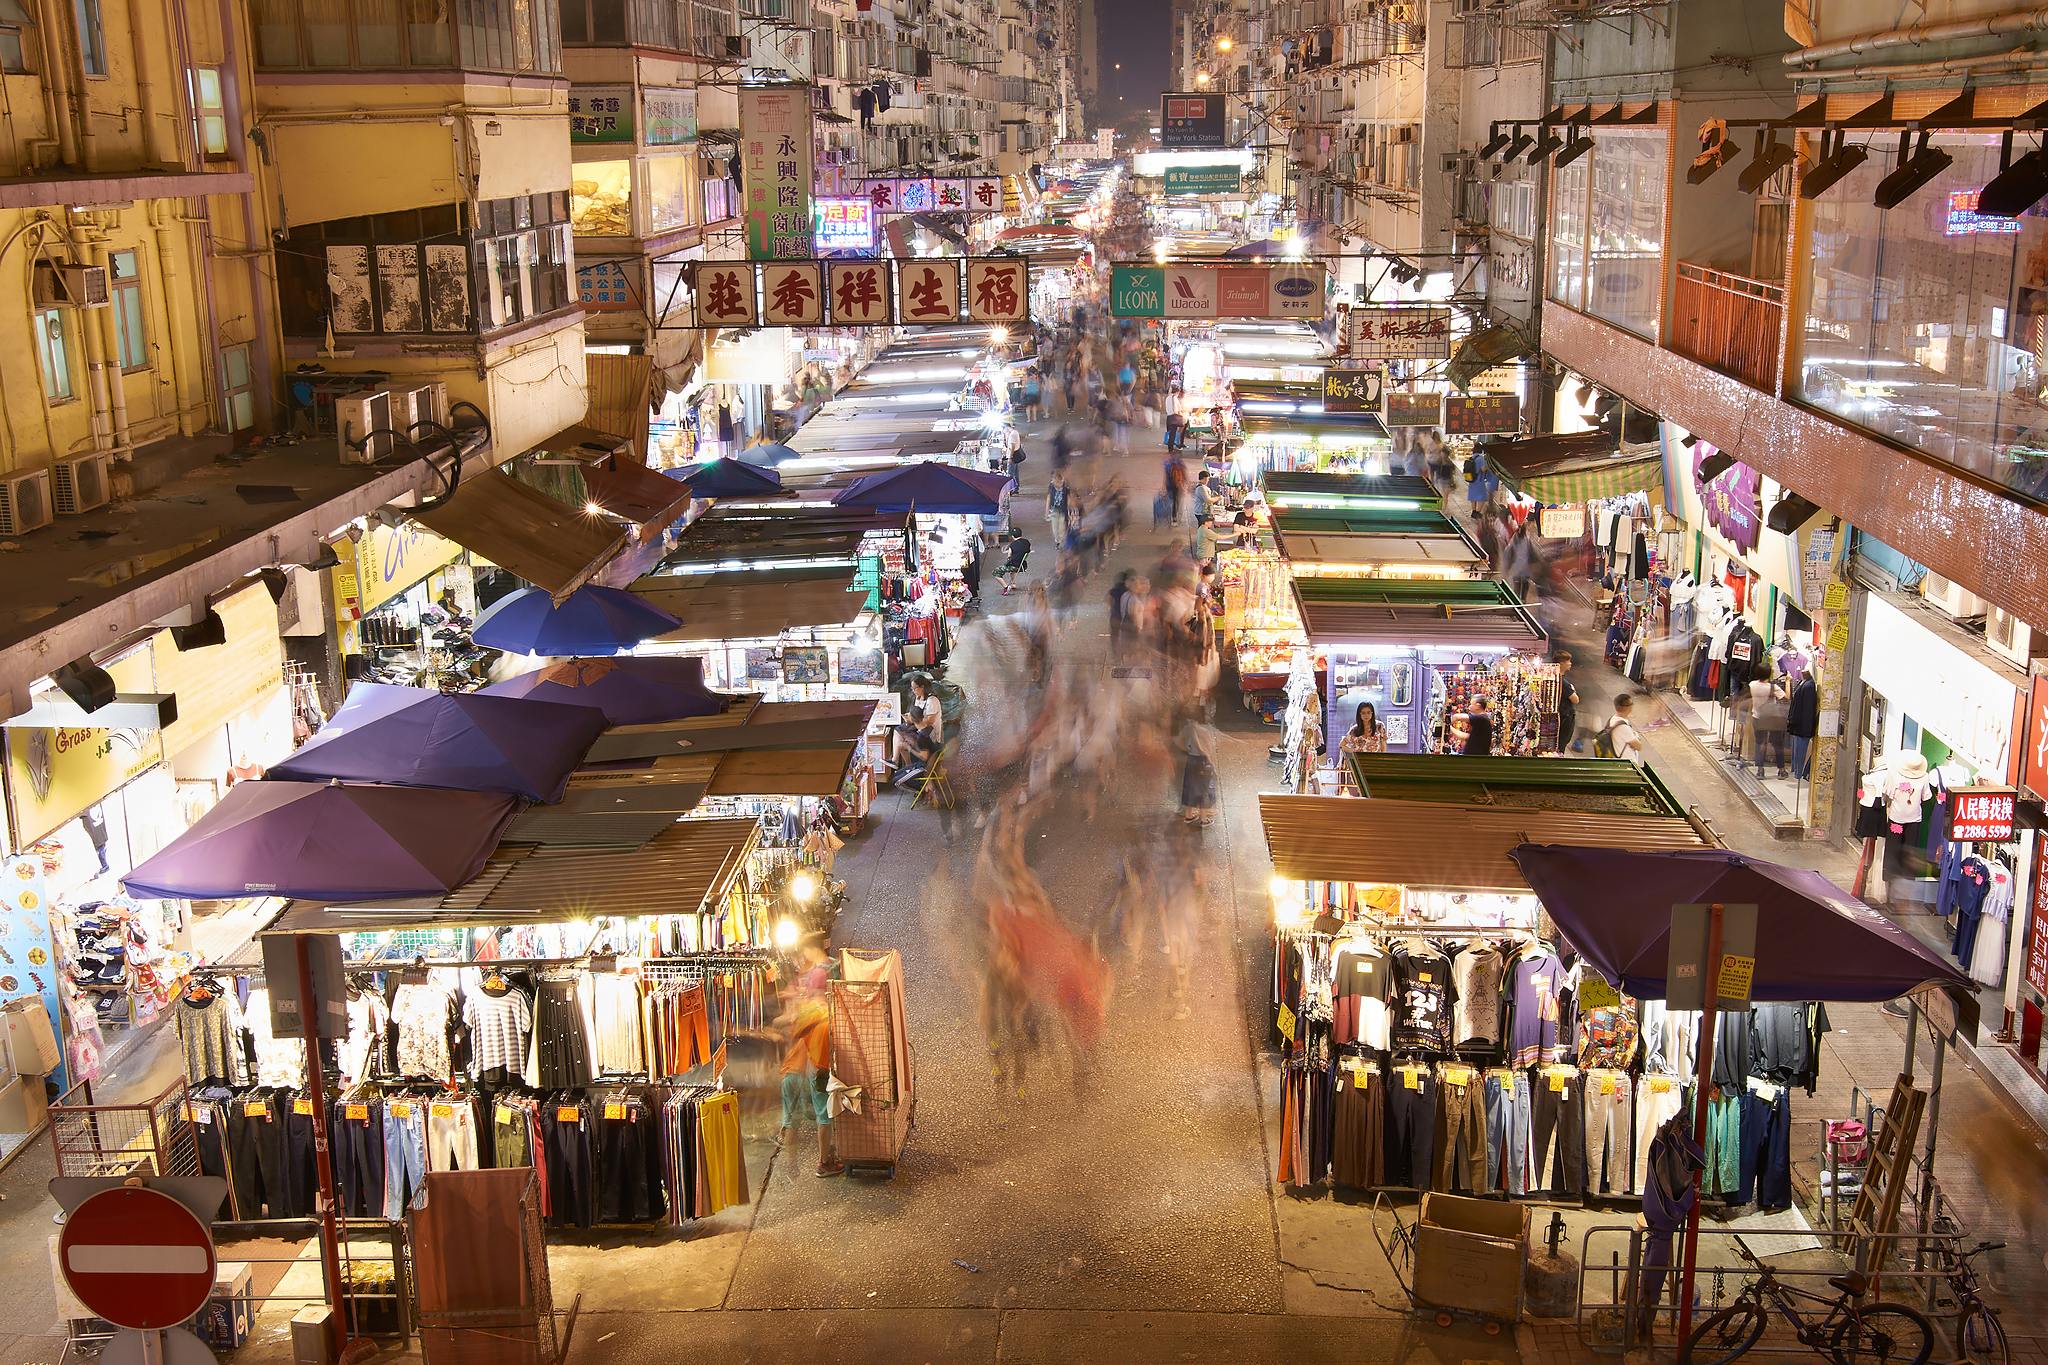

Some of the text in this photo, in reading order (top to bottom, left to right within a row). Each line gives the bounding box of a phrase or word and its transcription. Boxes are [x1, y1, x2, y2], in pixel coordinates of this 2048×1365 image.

[750, 141, 766, 202] 請上一樓
[776, 135, 800, 208] 永興隆
[826, 206, 865, 221] 足跡
[580, 278, 626, 290] 錢公道
[581, 292, 627, 303] 心保證
[1120, 290, 1158, 310] LEONA
[1226, 290, 1260, 300] Triumph
[1172, 299, 1210, 308] Wacoal
[56, 728, 92, 754] Grass
[1954, 797, 2013, 822] 人民幣找換
[1964, 824, 2012, 839] 2886 5599
